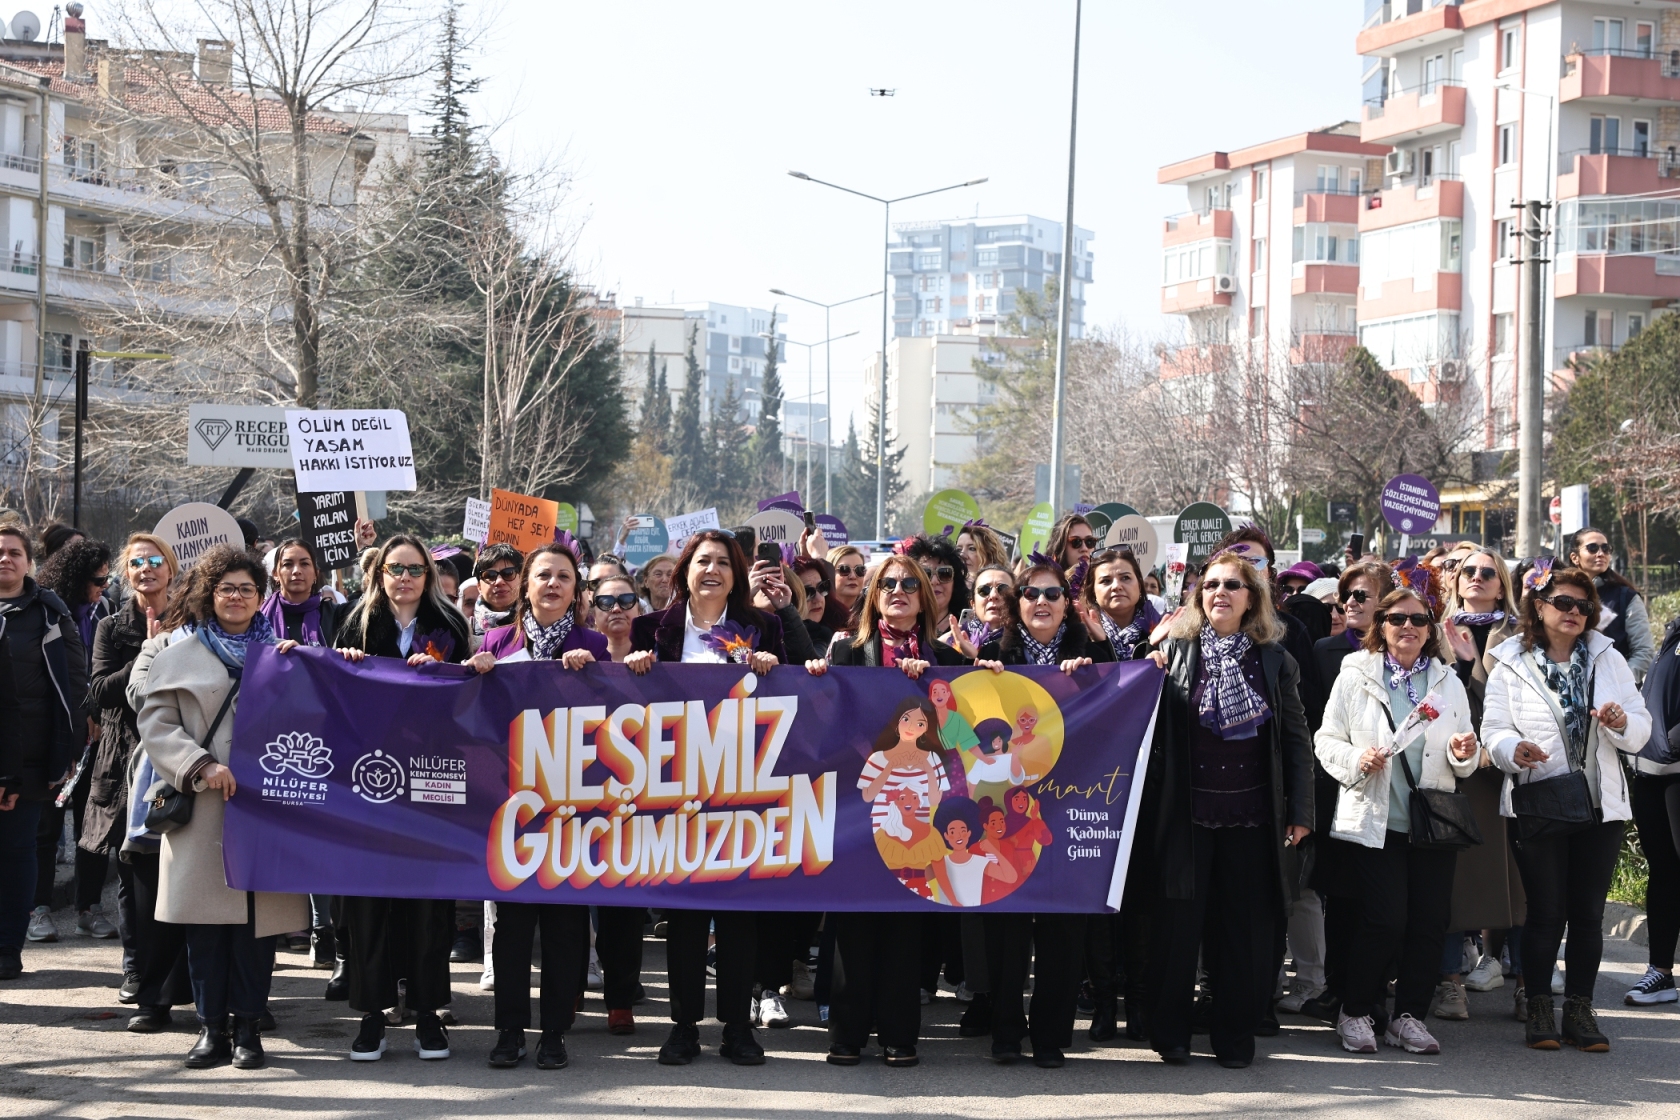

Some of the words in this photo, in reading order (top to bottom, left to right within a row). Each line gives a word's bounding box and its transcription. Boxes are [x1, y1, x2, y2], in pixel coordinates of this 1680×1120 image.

[206, 424, 223, 436] RT
[236, 420, 288, 434] RECEP
[298, 417, 346, 433] ÖLÜM
[352, 417, 392, 432] DEĞİL
[303, 438, 364, 454] YAŞAM
[300, 458, 340, 471] HAKKI
[1399, 481, 1428, 498] İSTANBUL
[312, 492, 345, 510] YARIM
[496, 496, 539, 518] DÜNYADA
[1384, 488, 1440, 512] SÖZLEŞMESİ'NDEN
[1384, 499, 1436, 520] VAZGEÇMİYORUZ!
[314, 510, 348, 528] KALAN
[668, 520, 688, 532] ERKEK
[1181, 520, 1200, 531] ERKEK
[1201, 518, 1223, 530] ADALET
[176, 517, 209, 540] KADIN
[508, 517, 524, 531] HER
[530, 522, 549, 538] ŞEY
[760, 524, 786, 540] KADIN
[1120, 527, 1138, 542] KADIN
[316, 530, 355, 548] HERKES
[1182, 530, 1200, 543] DEĞİL
[1200, 531, 1223, 544] GERÇEK
[1392, 537, 1437, 549] SÜDYO
[324, 546, 350, 566] İÇİN
[512, 672, 798, 806] NEŞEMİZ
[409, 754, 466, 771] NİLÜFER
[410, 770, 431, 778] KENT
[431, 772, 466, 780] KONSEYİ
[263, 776, 328, 792] NİLÜFER
[424, 781, 452, 789] KADIN
[1038, 766, 1129, 804] mart
[262, 788, 326, 800] BELEDİYESİ
[423, 794, 454, 802] MECLİSİ
[1066, 808, 1109, 824] Dünya
[494, 771, 838, 885] GÜCÜMÜZDEN
[1066, 826, 1122, 841] Kadınlar
[1067, 845, 1101, 861] Günü
